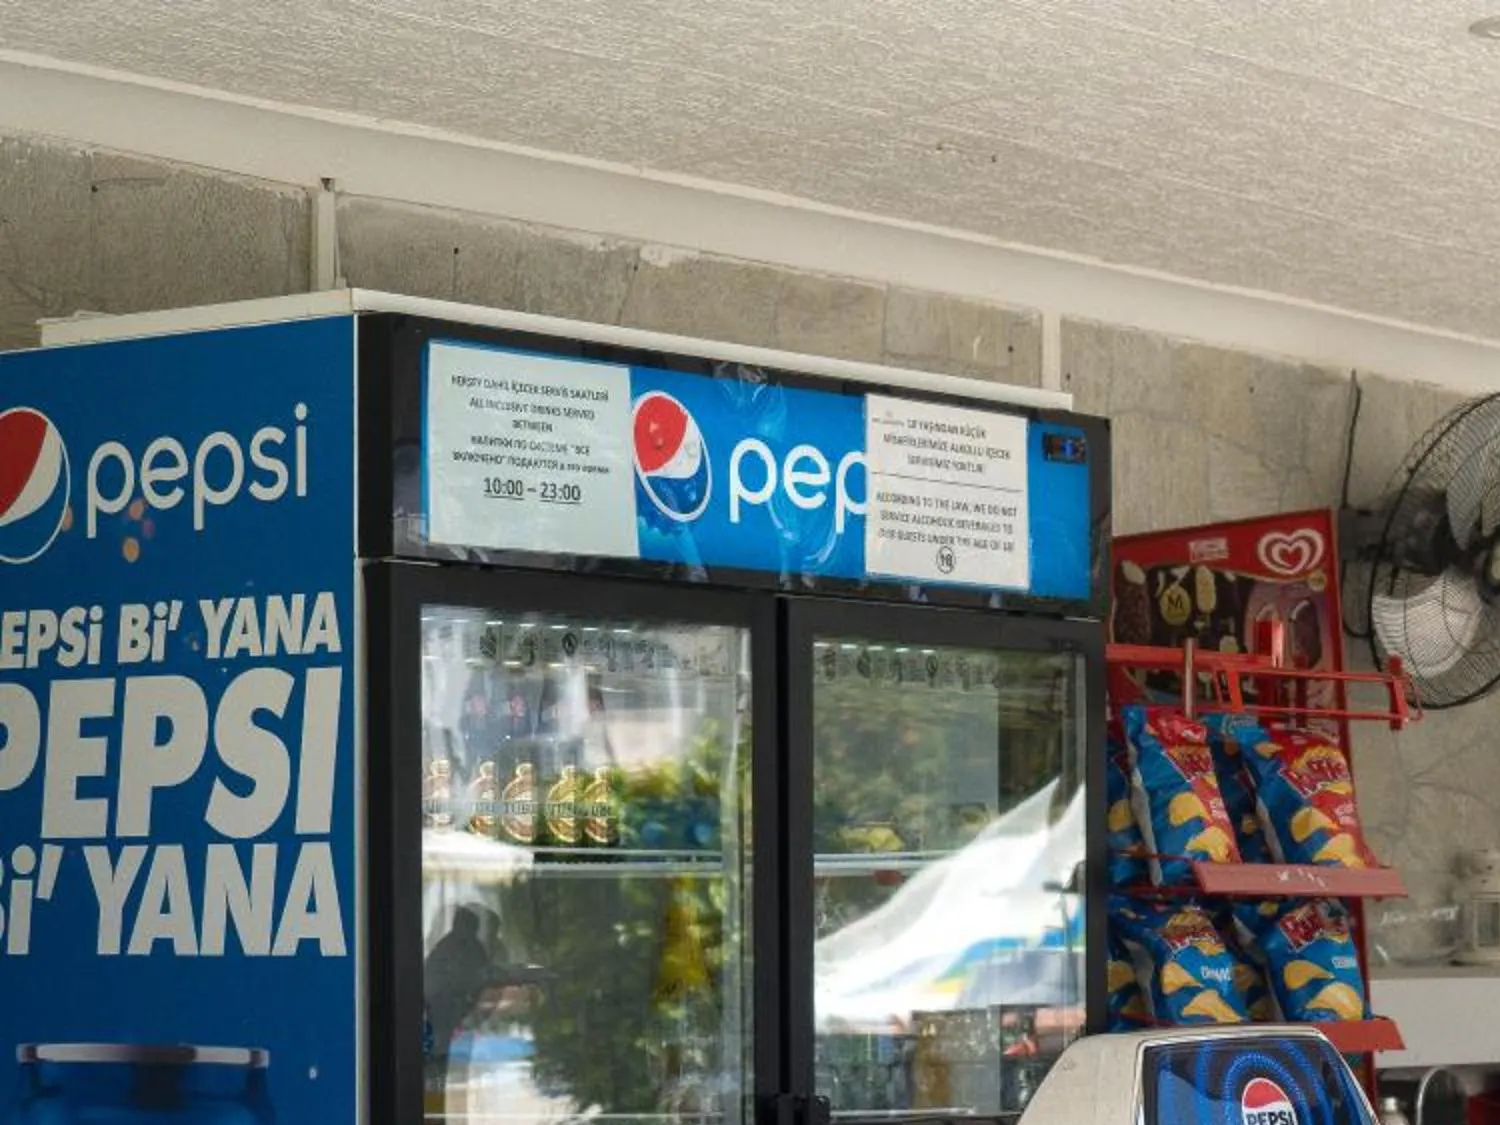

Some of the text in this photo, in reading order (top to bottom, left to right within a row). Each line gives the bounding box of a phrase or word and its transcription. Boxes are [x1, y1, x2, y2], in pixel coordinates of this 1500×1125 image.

[86, 402, 308, 538] pepsi
[483, 477, 524, 497] 10:00
[540, 481, 582, 501] 23:00
[200, 591, 343, 660] YANA
[83, 841, 347, 957] YANA
